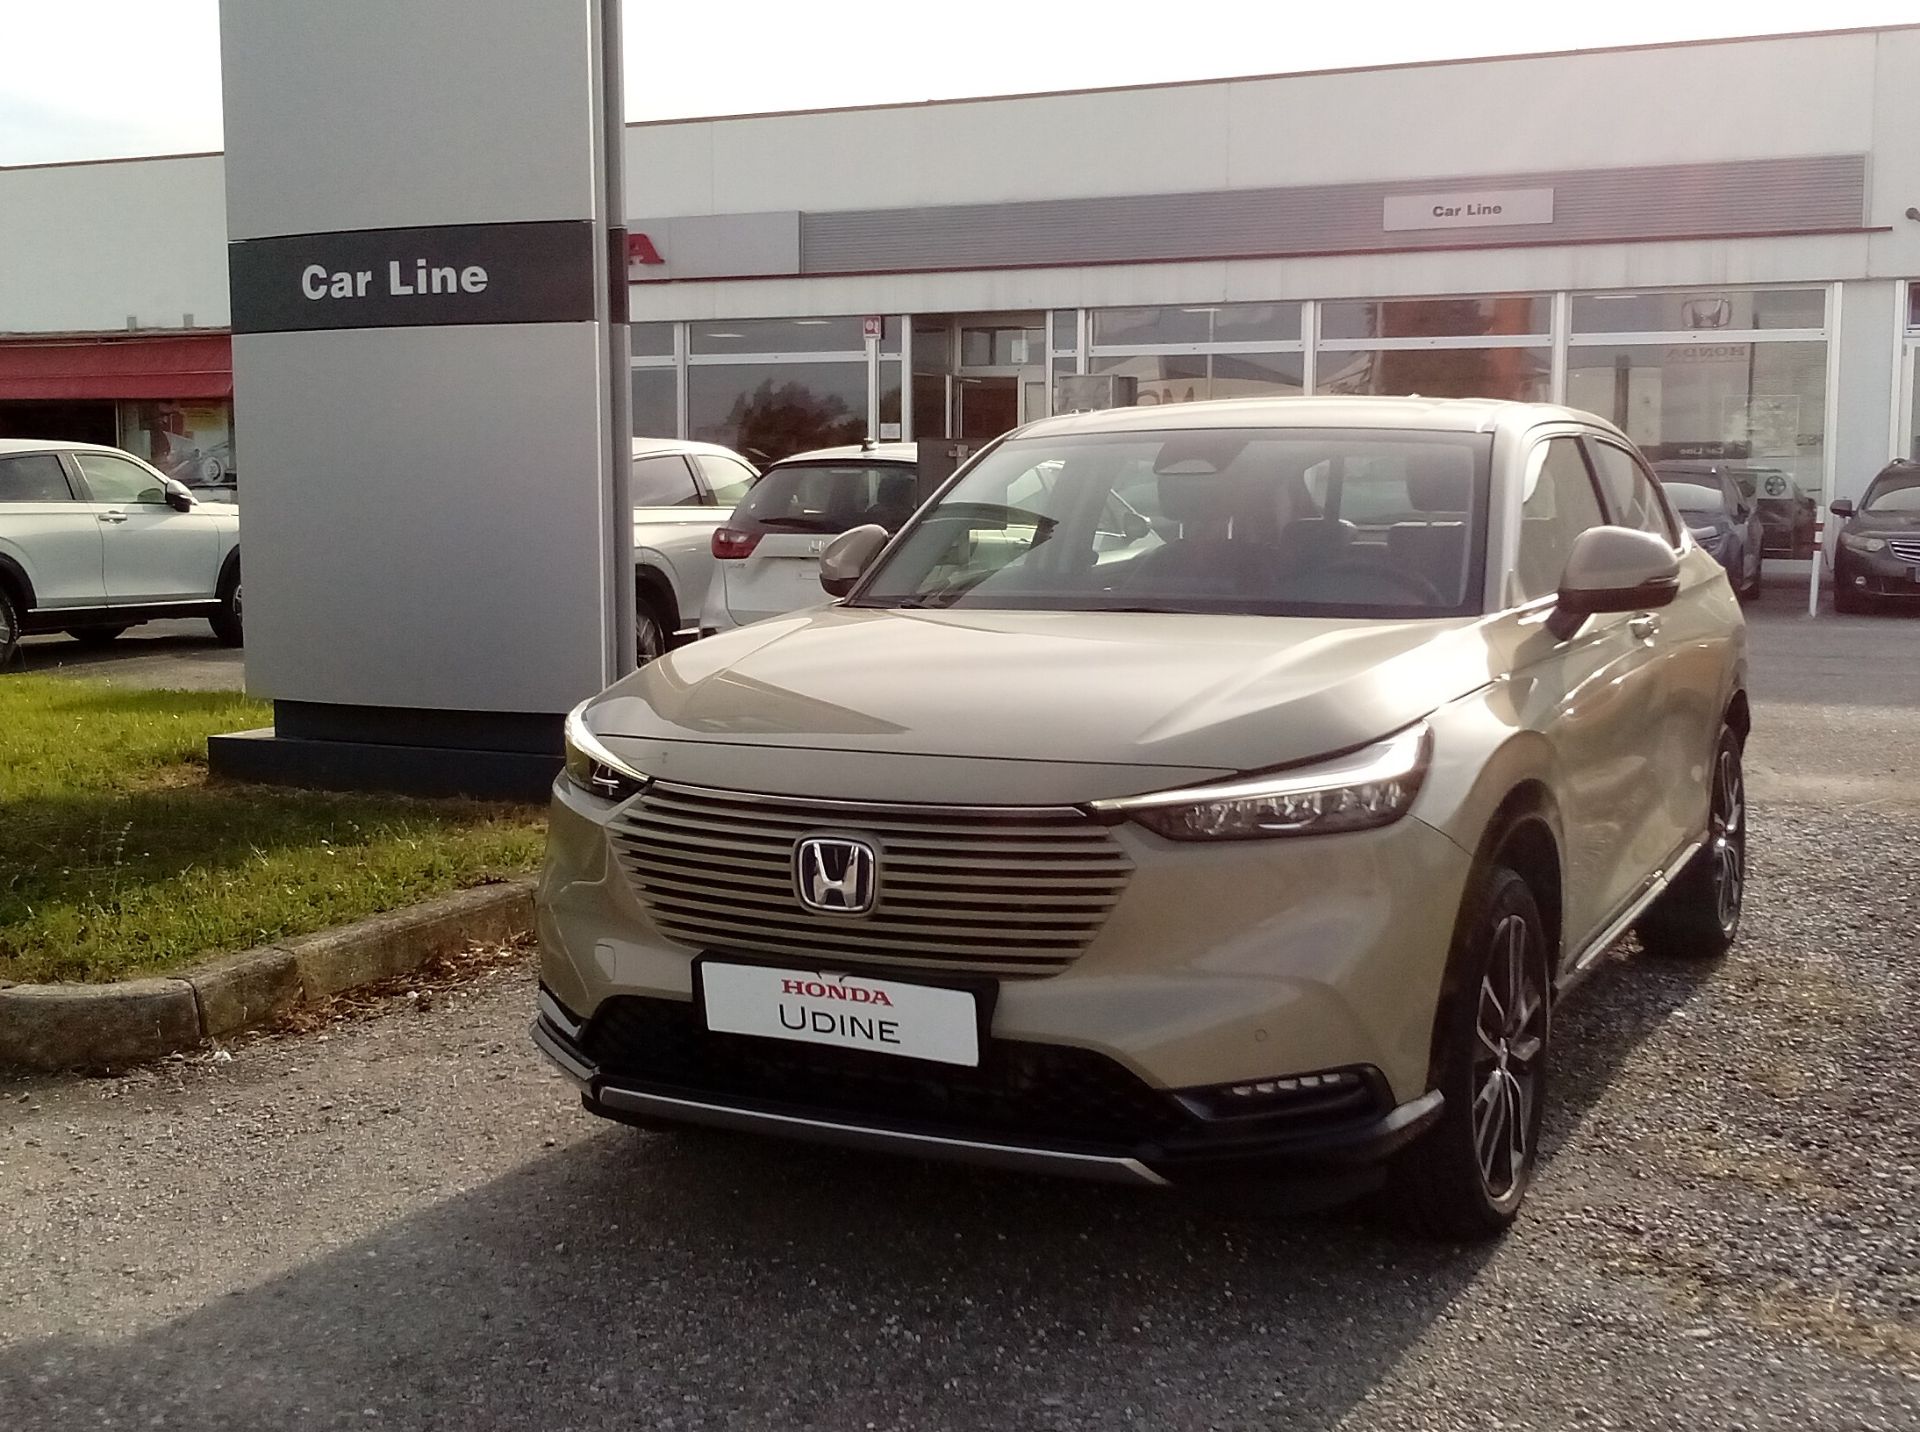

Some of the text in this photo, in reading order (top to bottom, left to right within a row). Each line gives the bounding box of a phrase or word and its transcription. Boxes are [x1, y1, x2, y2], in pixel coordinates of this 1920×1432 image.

[1432, 203, 1502, 217] Car Line
[301, 258, 489, 300] Car Line
[781, 979, 894, 1007] HONDA
[779, 1003, 901, 1044] UDINE
